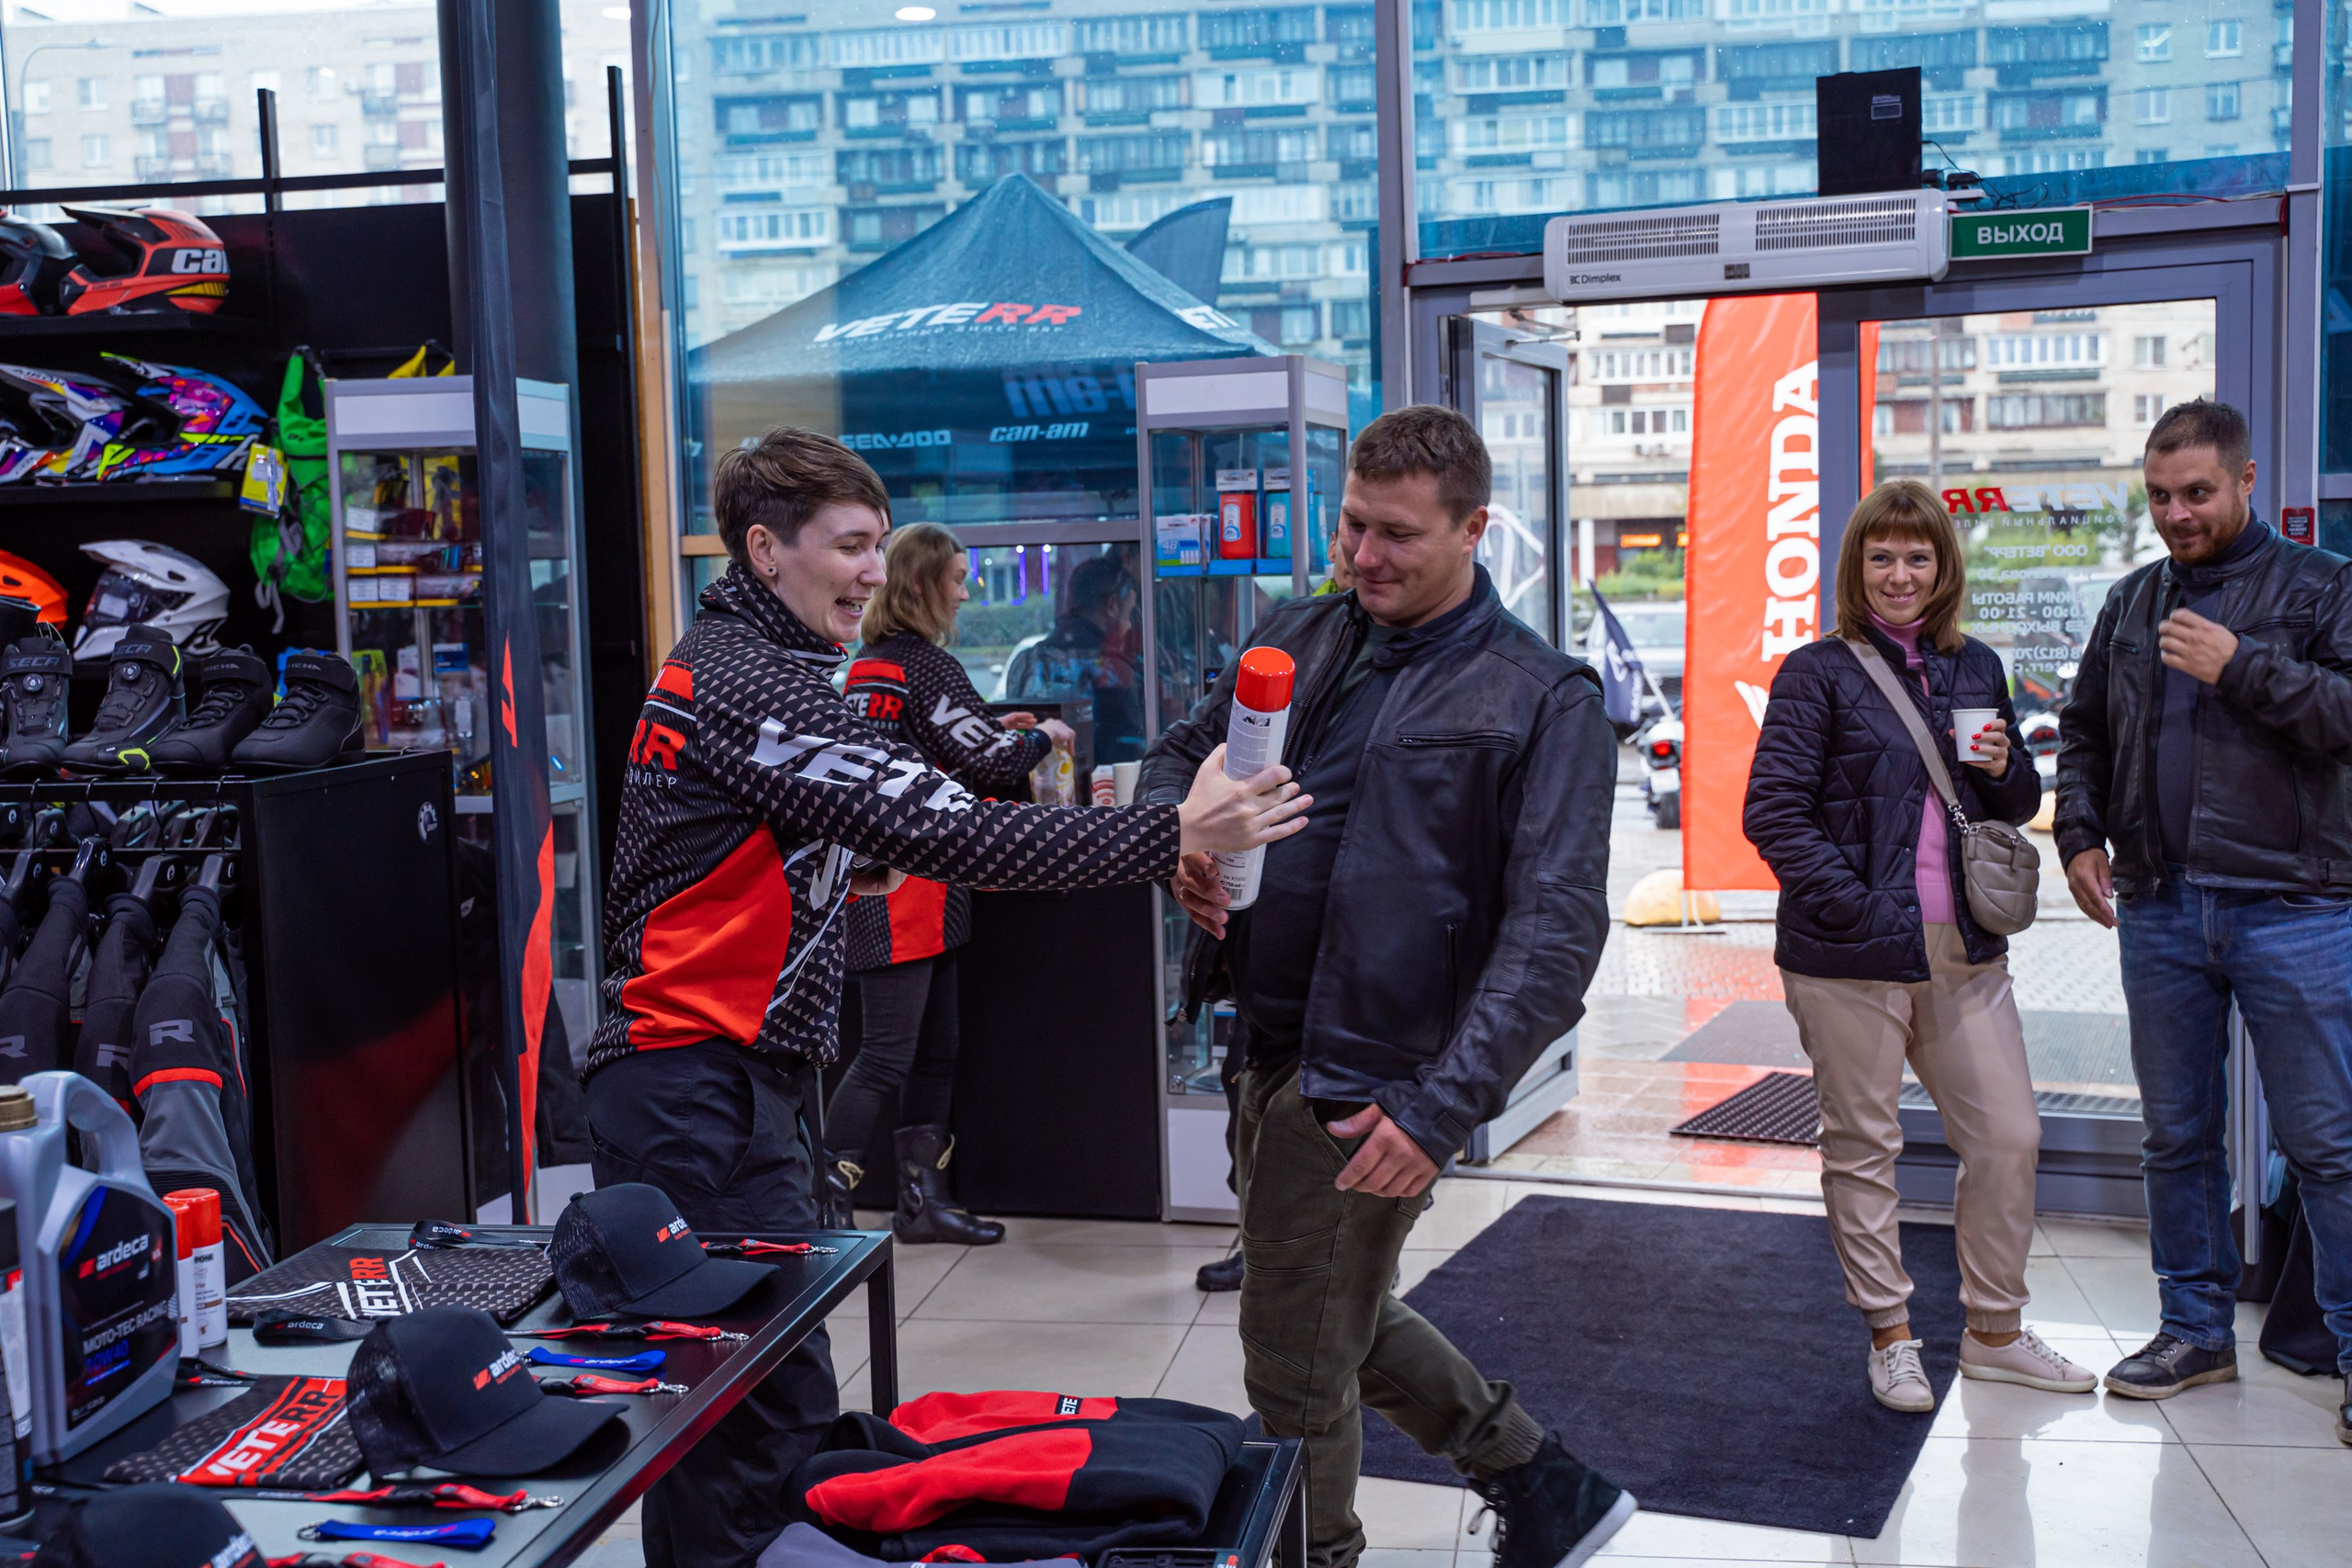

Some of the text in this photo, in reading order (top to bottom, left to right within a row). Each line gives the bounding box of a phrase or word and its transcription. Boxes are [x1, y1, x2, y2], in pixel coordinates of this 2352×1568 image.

[1977, 222, 2064, 244] ВЫХОД
[1581, 274, 1622, 284] Dimplex
[813, 301, 1082, 344] VETERR
[989, 422, 1090, 443] can-am
[1761, 360, 1819, 662] HONDA
[1162, 539, 1178, 549] 48
[8, 657, 60, 667] SECA
[96, 1234, 150, 1272] ardeca
[288, 1321, 324, 1329] ardeca
